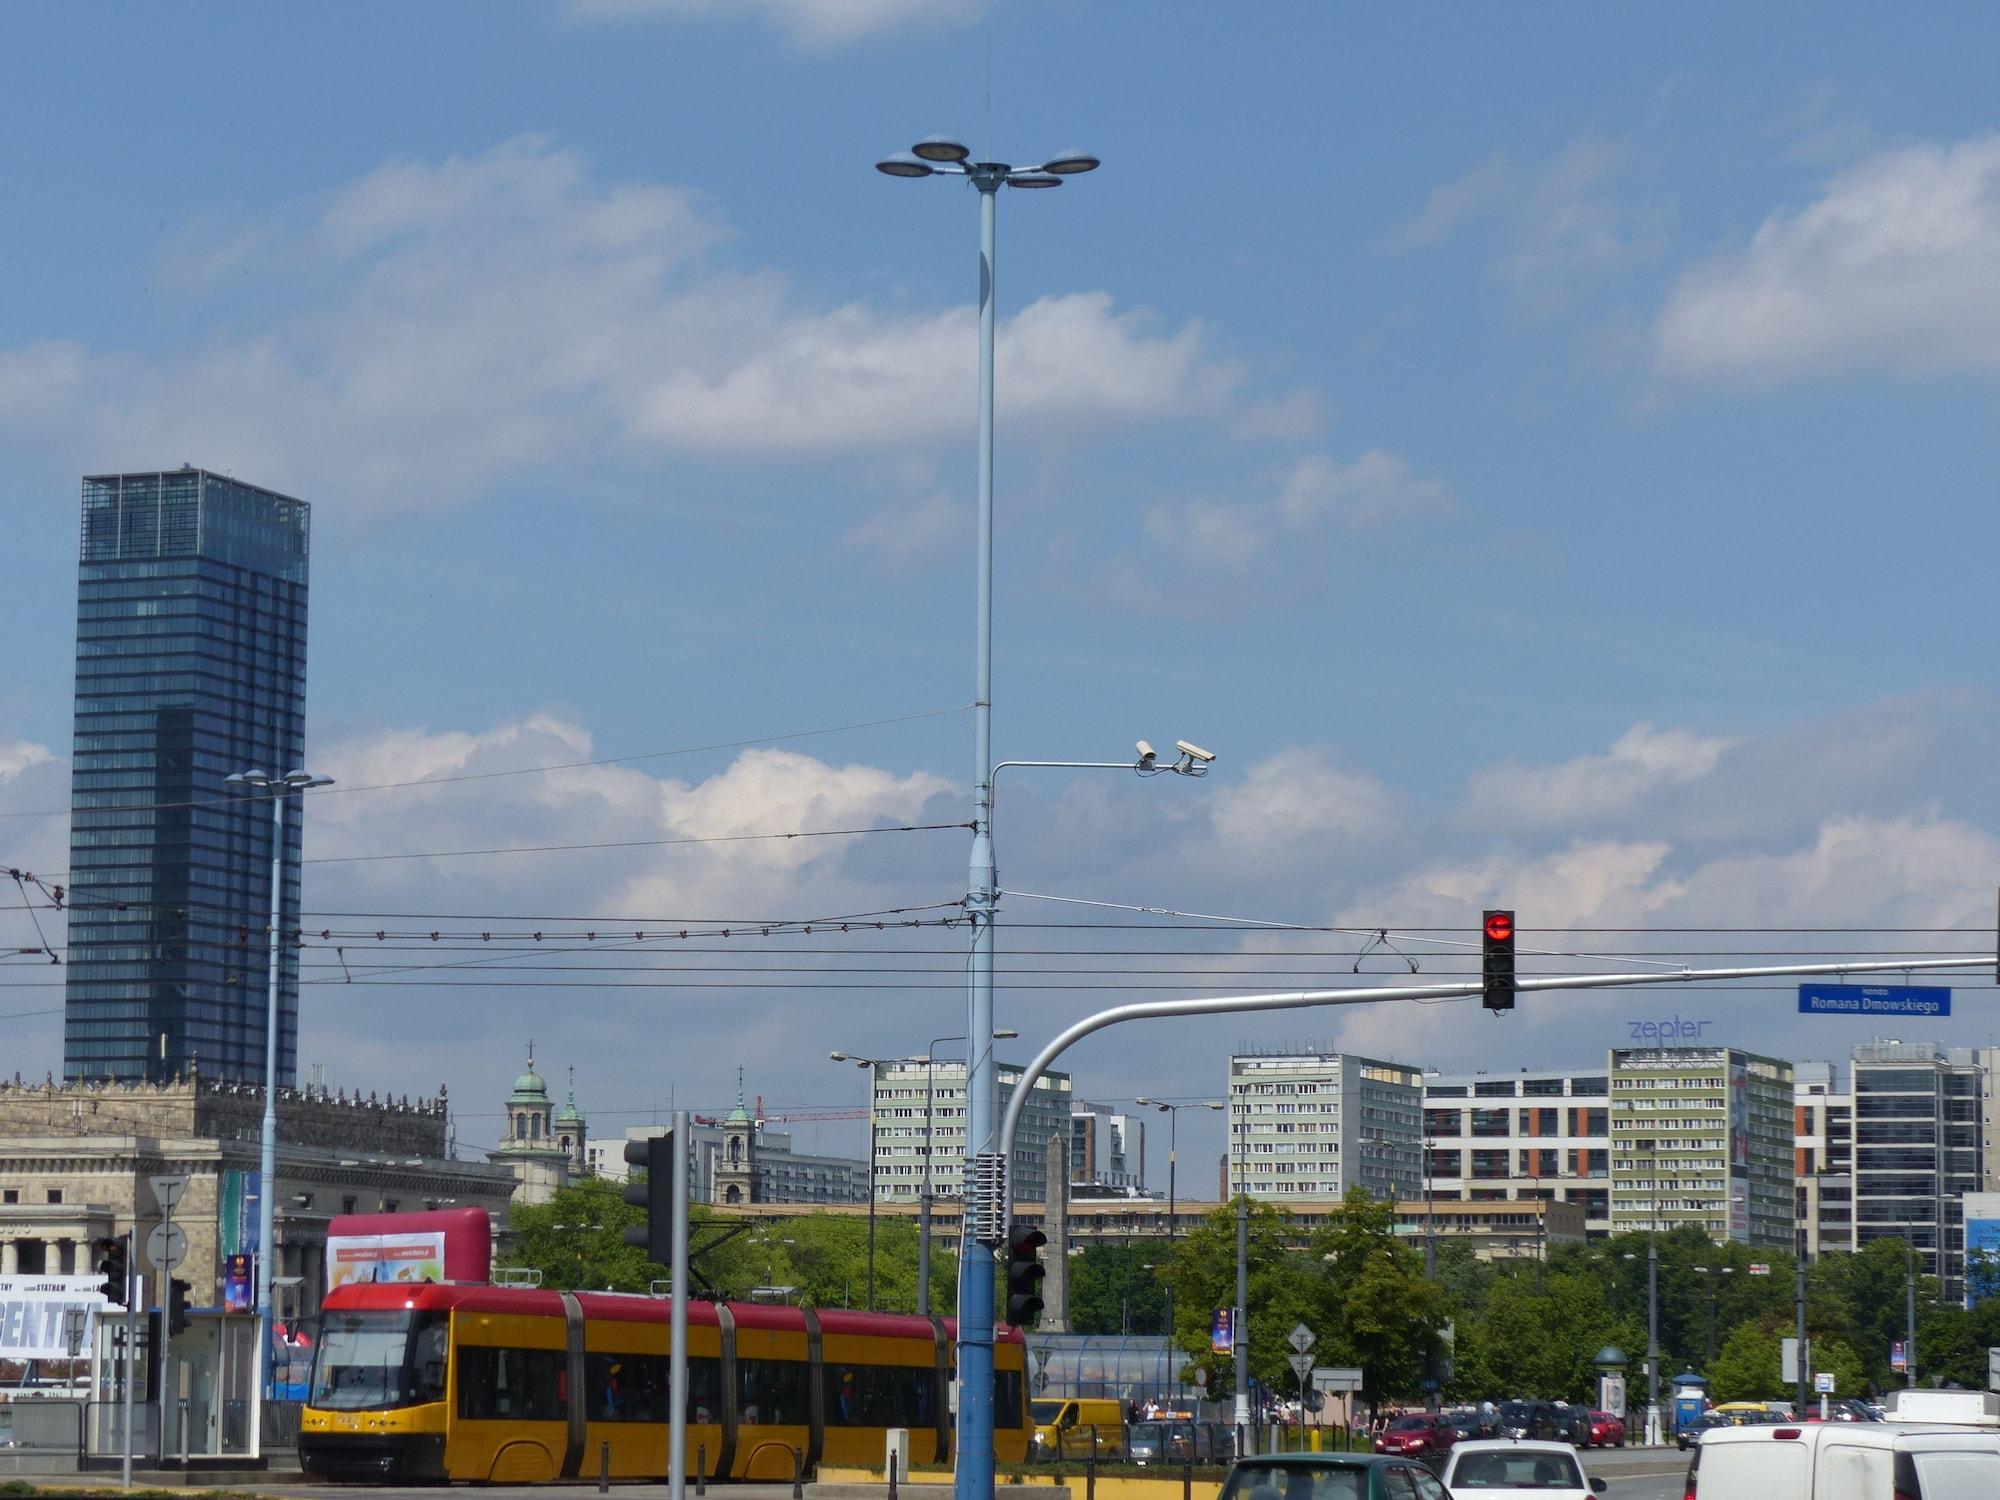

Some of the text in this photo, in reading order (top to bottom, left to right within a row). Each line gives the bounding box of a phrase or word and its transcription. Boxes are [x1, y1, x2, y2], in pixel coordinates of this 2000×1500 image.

[1811, 997, 1939, 1014] Romana Dmowskiego
[1627, 1014, 1713, 1044] zepter
[36, 1283, 66, 1292] STATHAM
